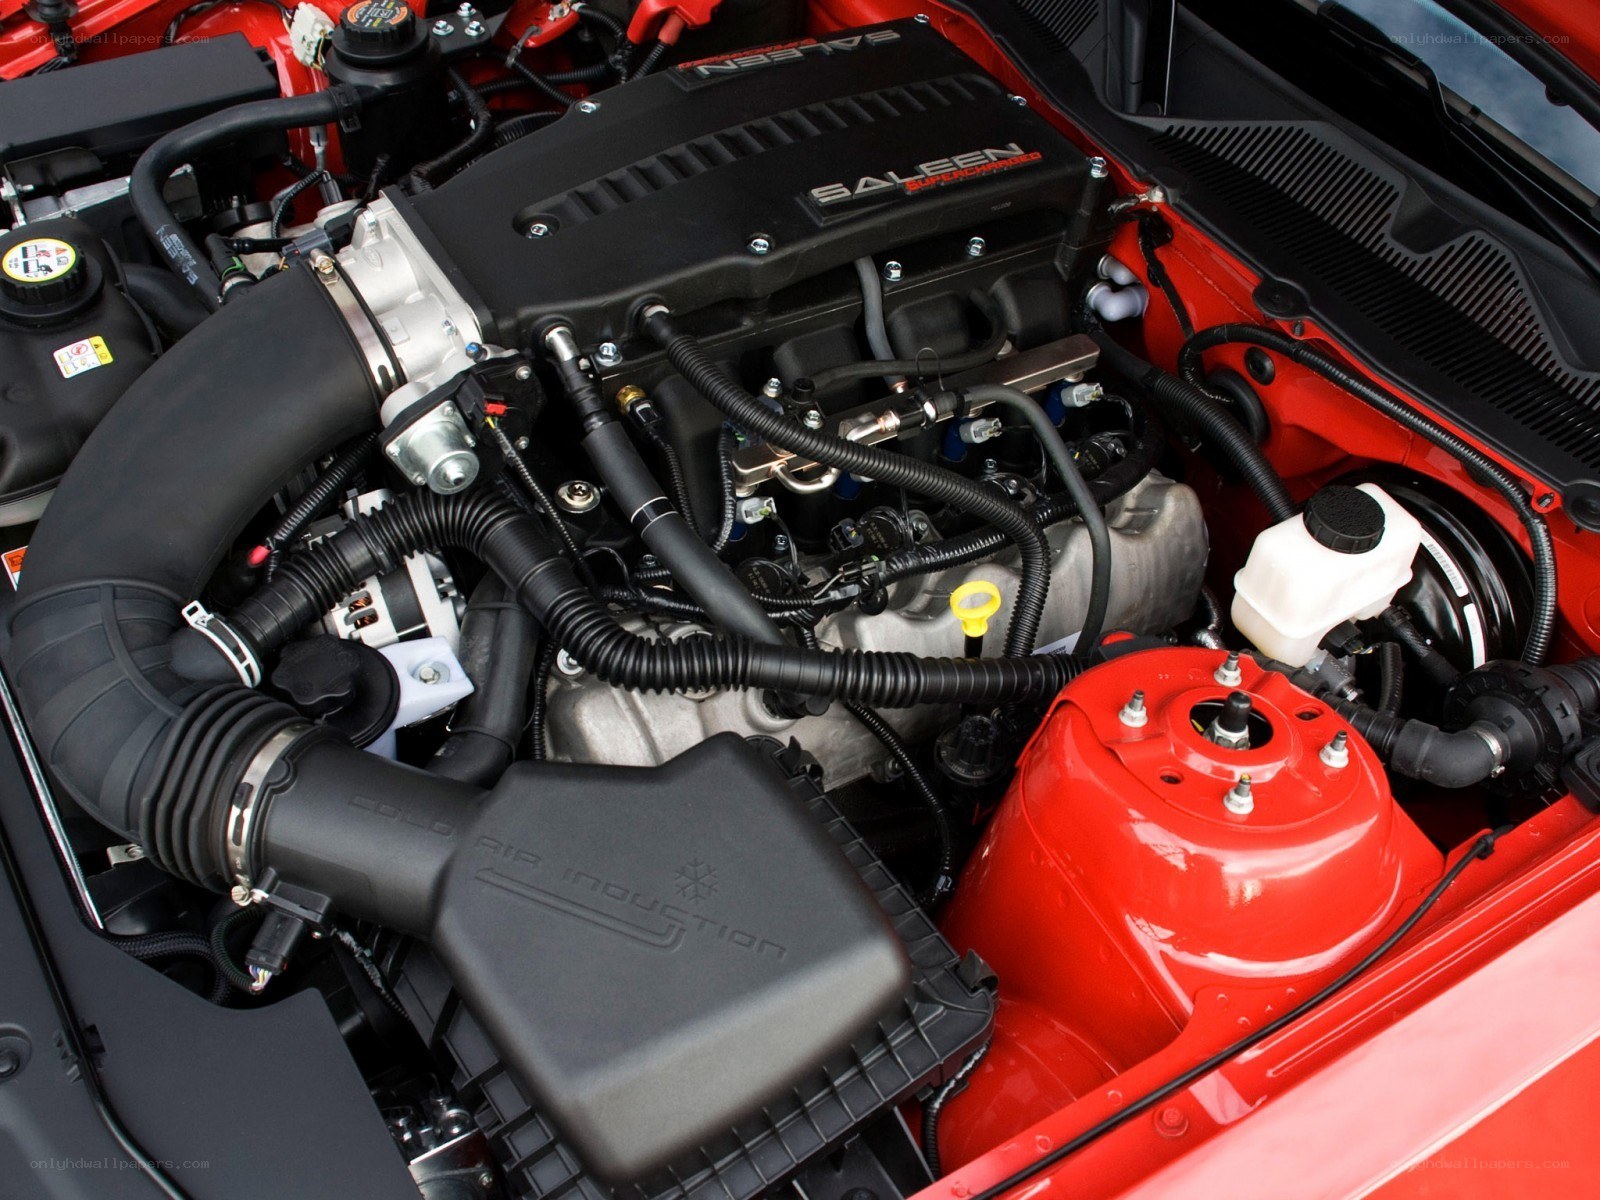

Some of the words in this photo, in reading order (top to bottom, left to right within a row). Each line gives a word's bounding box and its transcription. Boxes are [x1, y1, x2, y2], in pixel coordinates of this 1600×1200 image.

[695, 29, 901, 76] SALEEN
[810, 142, 1025, 204] SALEEN
[903, 151, 1042, 192] SUPERCHARGED
[347, 795, 453, 837] COLD
[474, 835, 542, 865] AIR
